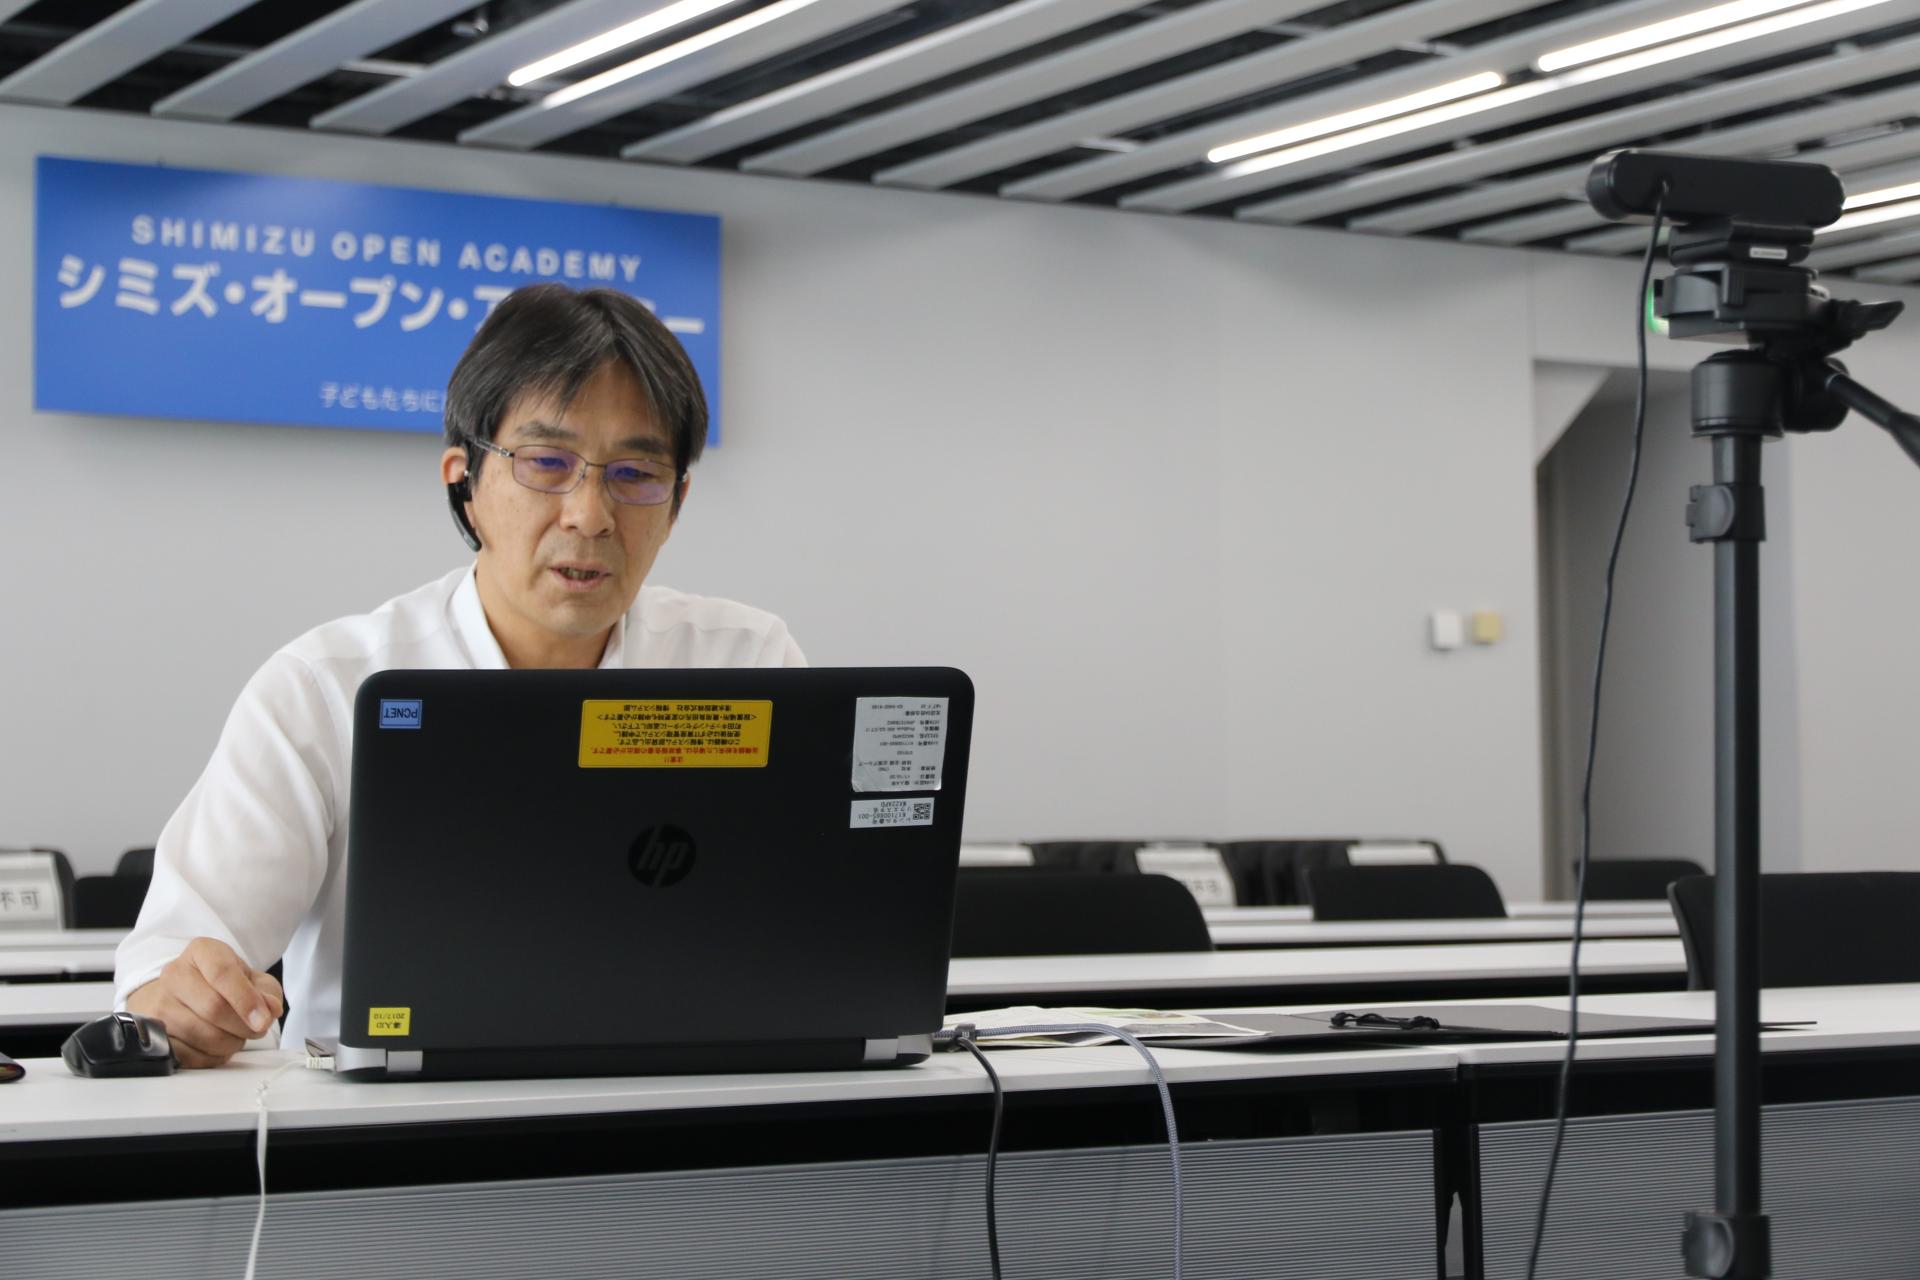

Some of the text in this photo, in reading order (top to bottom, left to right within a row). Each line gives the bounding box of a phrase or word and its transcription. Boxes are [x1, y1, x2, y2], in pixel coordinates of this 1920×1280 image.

[131, 216, 642, 281] SHIMIZU OPEN ACADEMY
[383, 707, 418, 719] PCNET
[637, 824, 689, 888] hp
